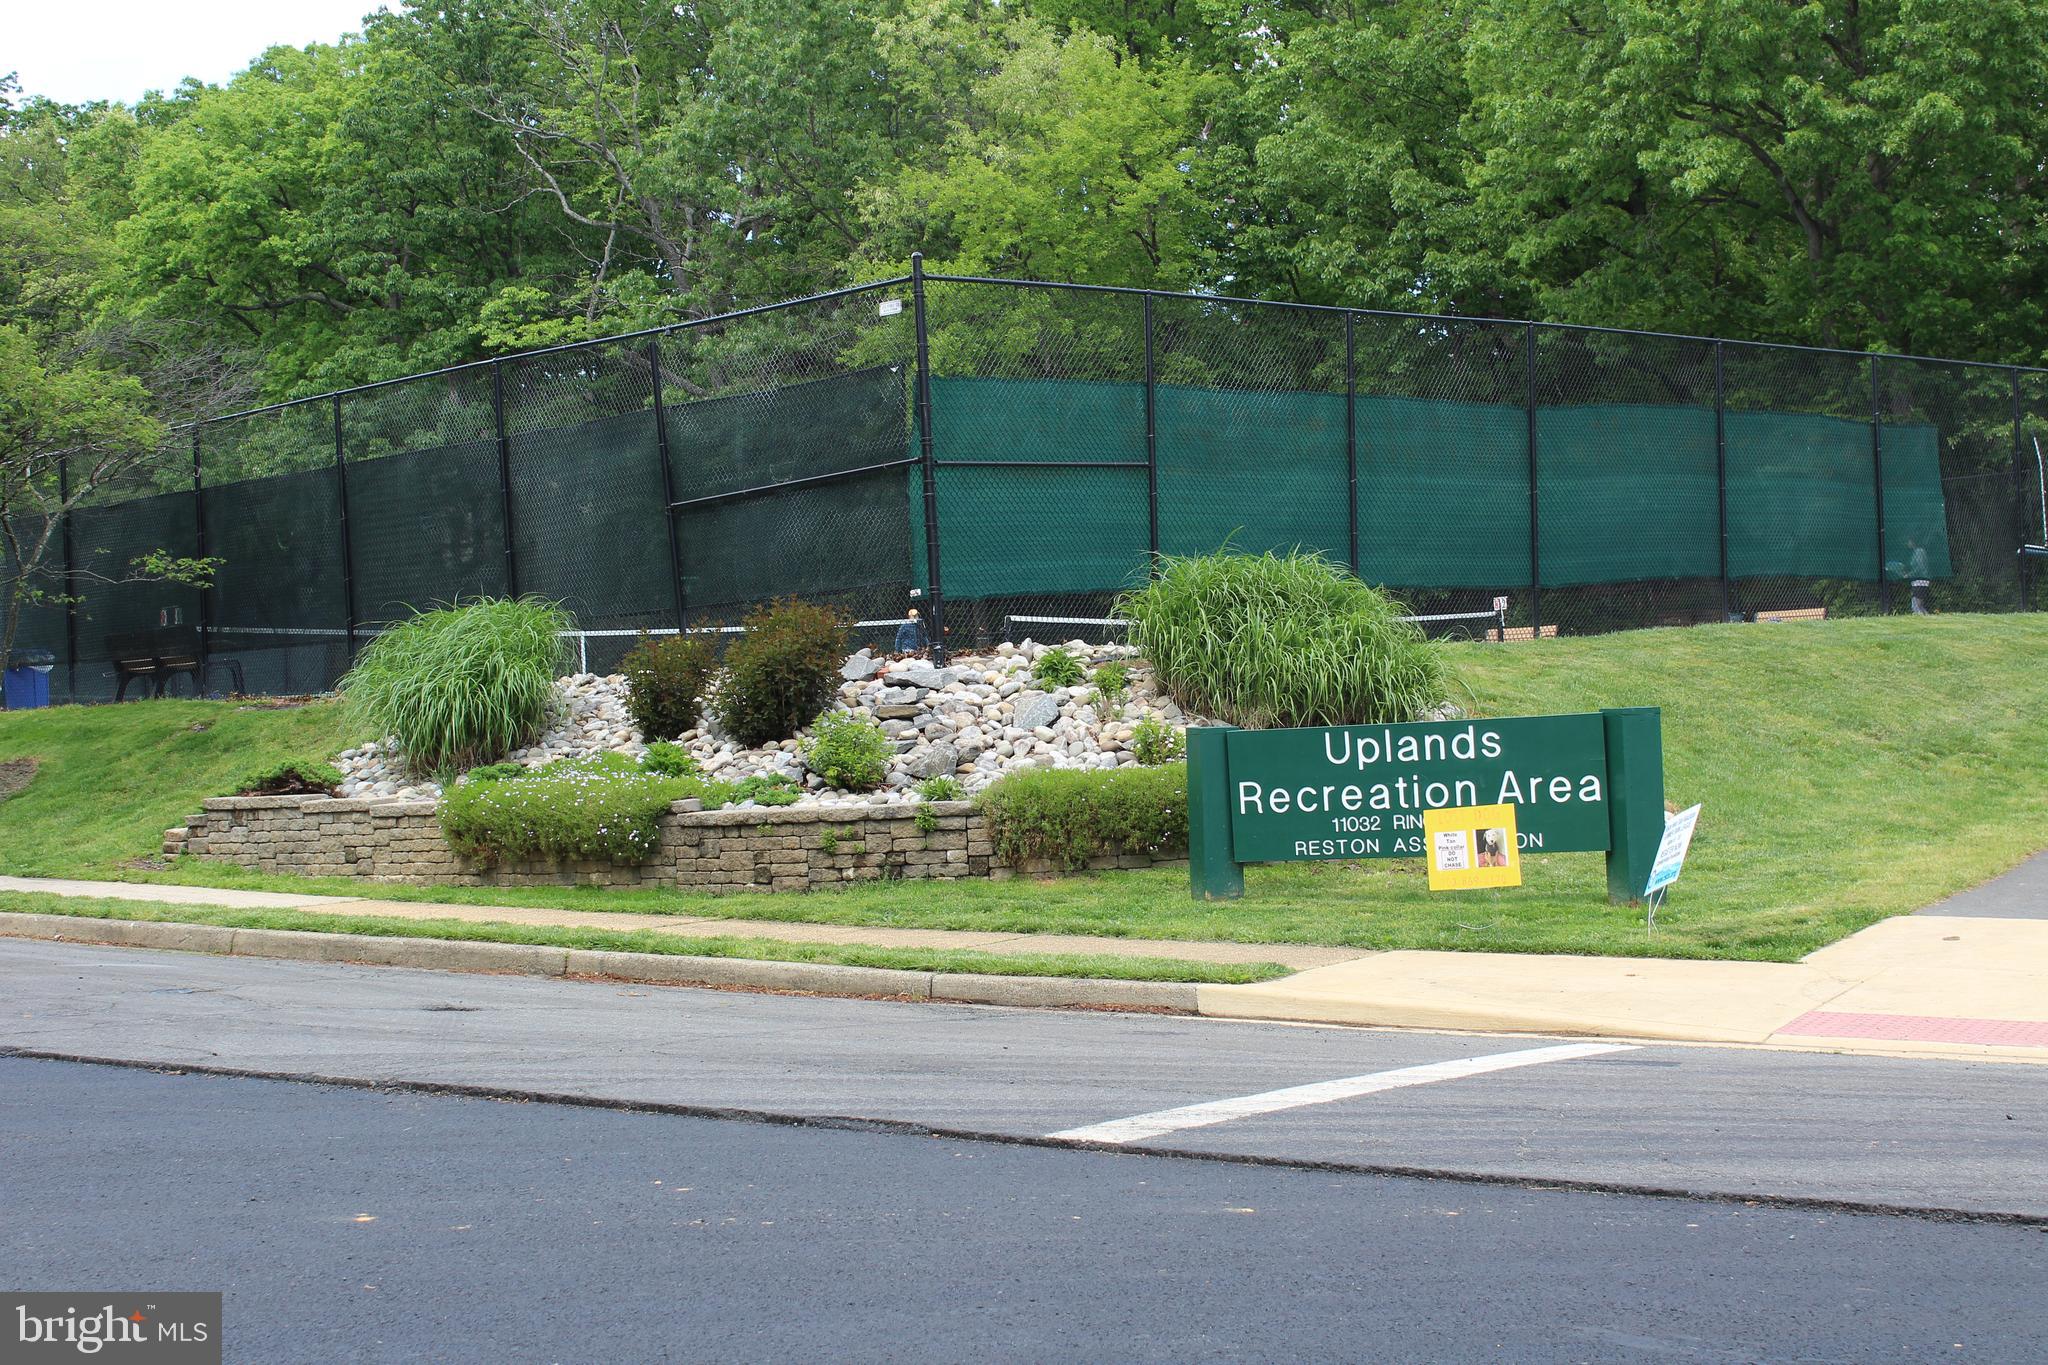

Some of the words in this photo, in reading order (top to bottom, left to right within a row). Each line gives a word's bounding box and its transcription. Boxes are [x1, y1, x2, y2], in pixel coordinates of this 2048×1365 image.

[1324, 725, 1502, 770] Uplands
[1238, 775, 1477, 815] Recreation
[1498, 770, 1602, 806] Area
[1332, 816, 1381, 833] 11032
[1393, 814, 1424, 830] RIN
[1295, 838, 1380, 856] RESTON
